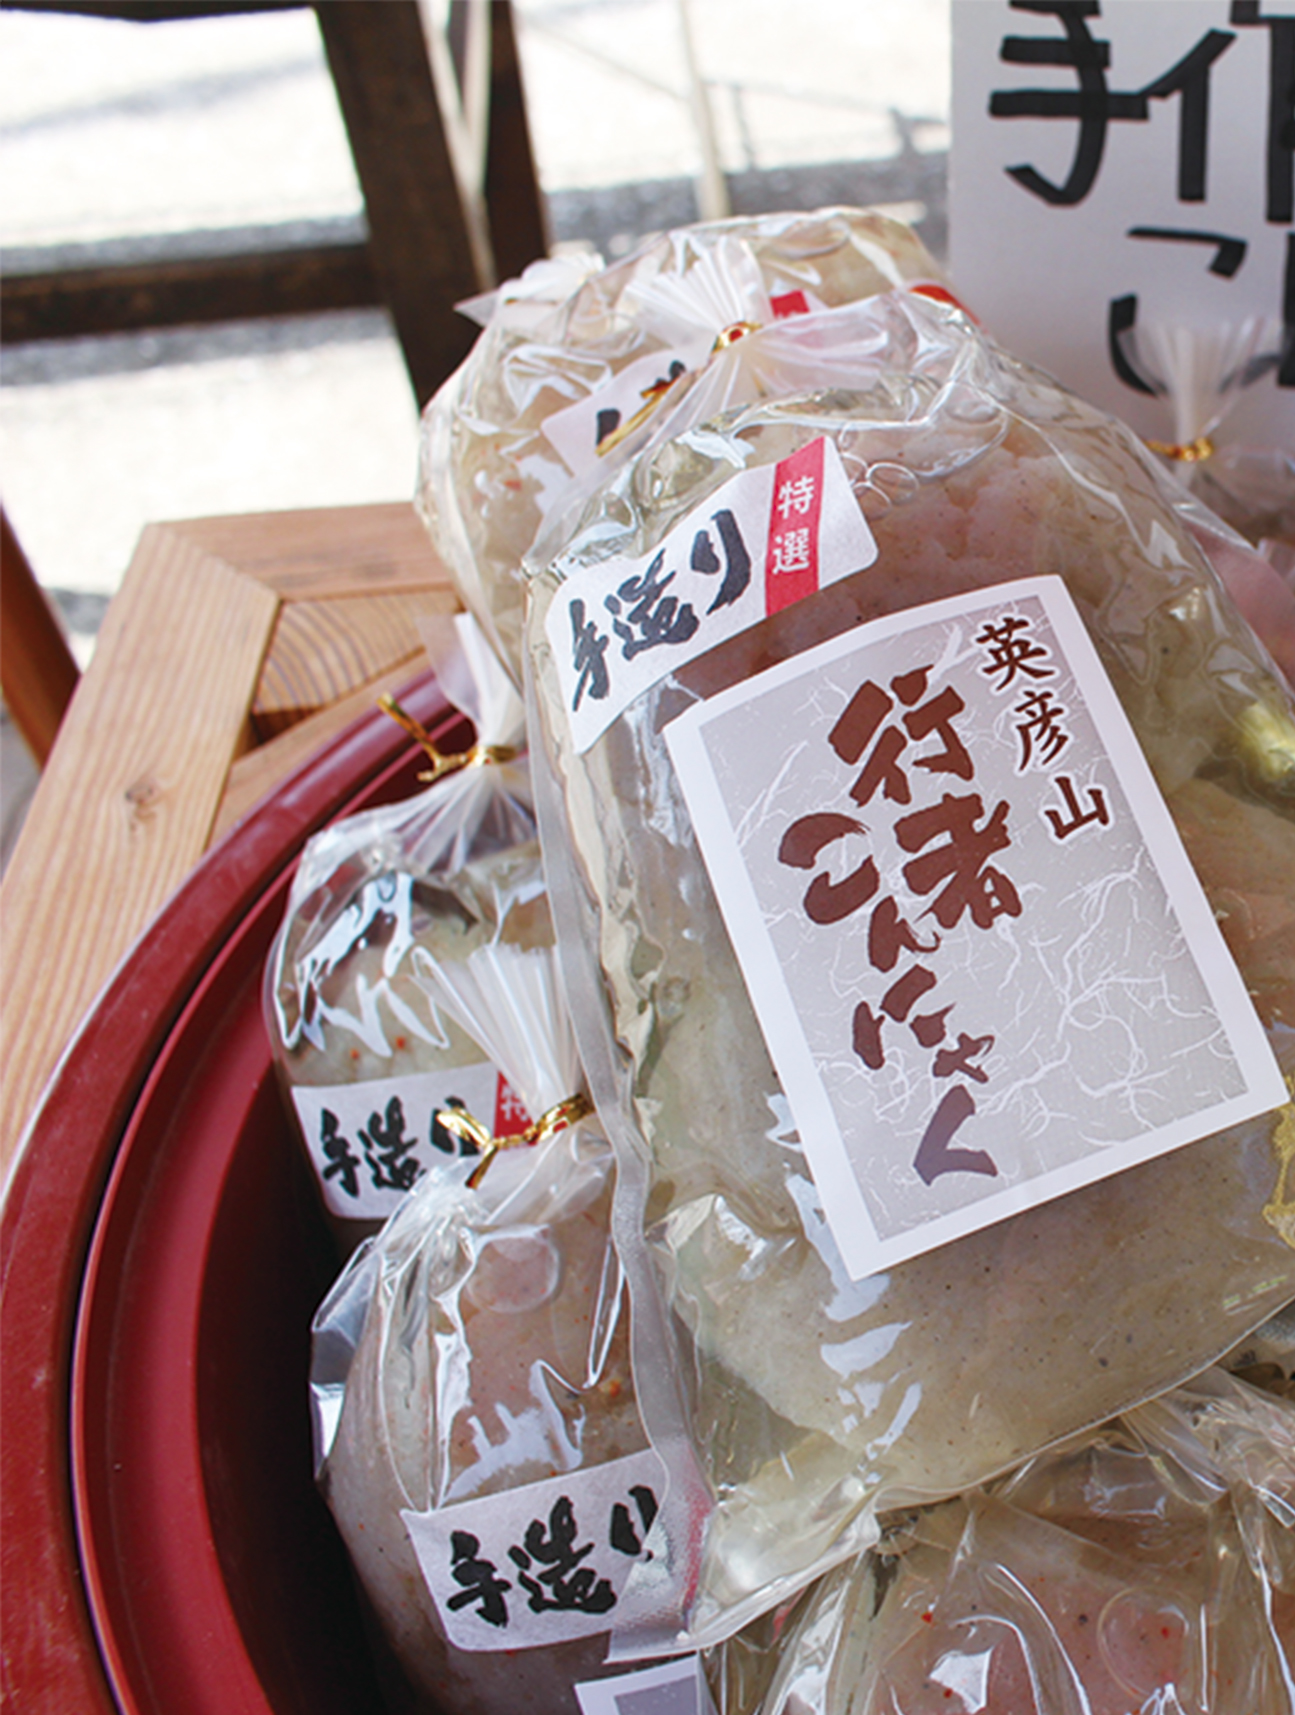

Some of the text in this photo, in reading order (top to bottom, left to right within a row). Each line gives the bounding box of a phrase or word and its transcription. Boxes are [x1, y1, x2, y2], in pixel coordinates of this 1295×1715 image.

[572, 509, 752, 712] 手造り
[772, 475, 815, 577] 特選
[828, 663, 1023, 930] 行者
[976, 616, 1111, 843] 英彦山
[778, 812, 999, 1187] こんにゃく
